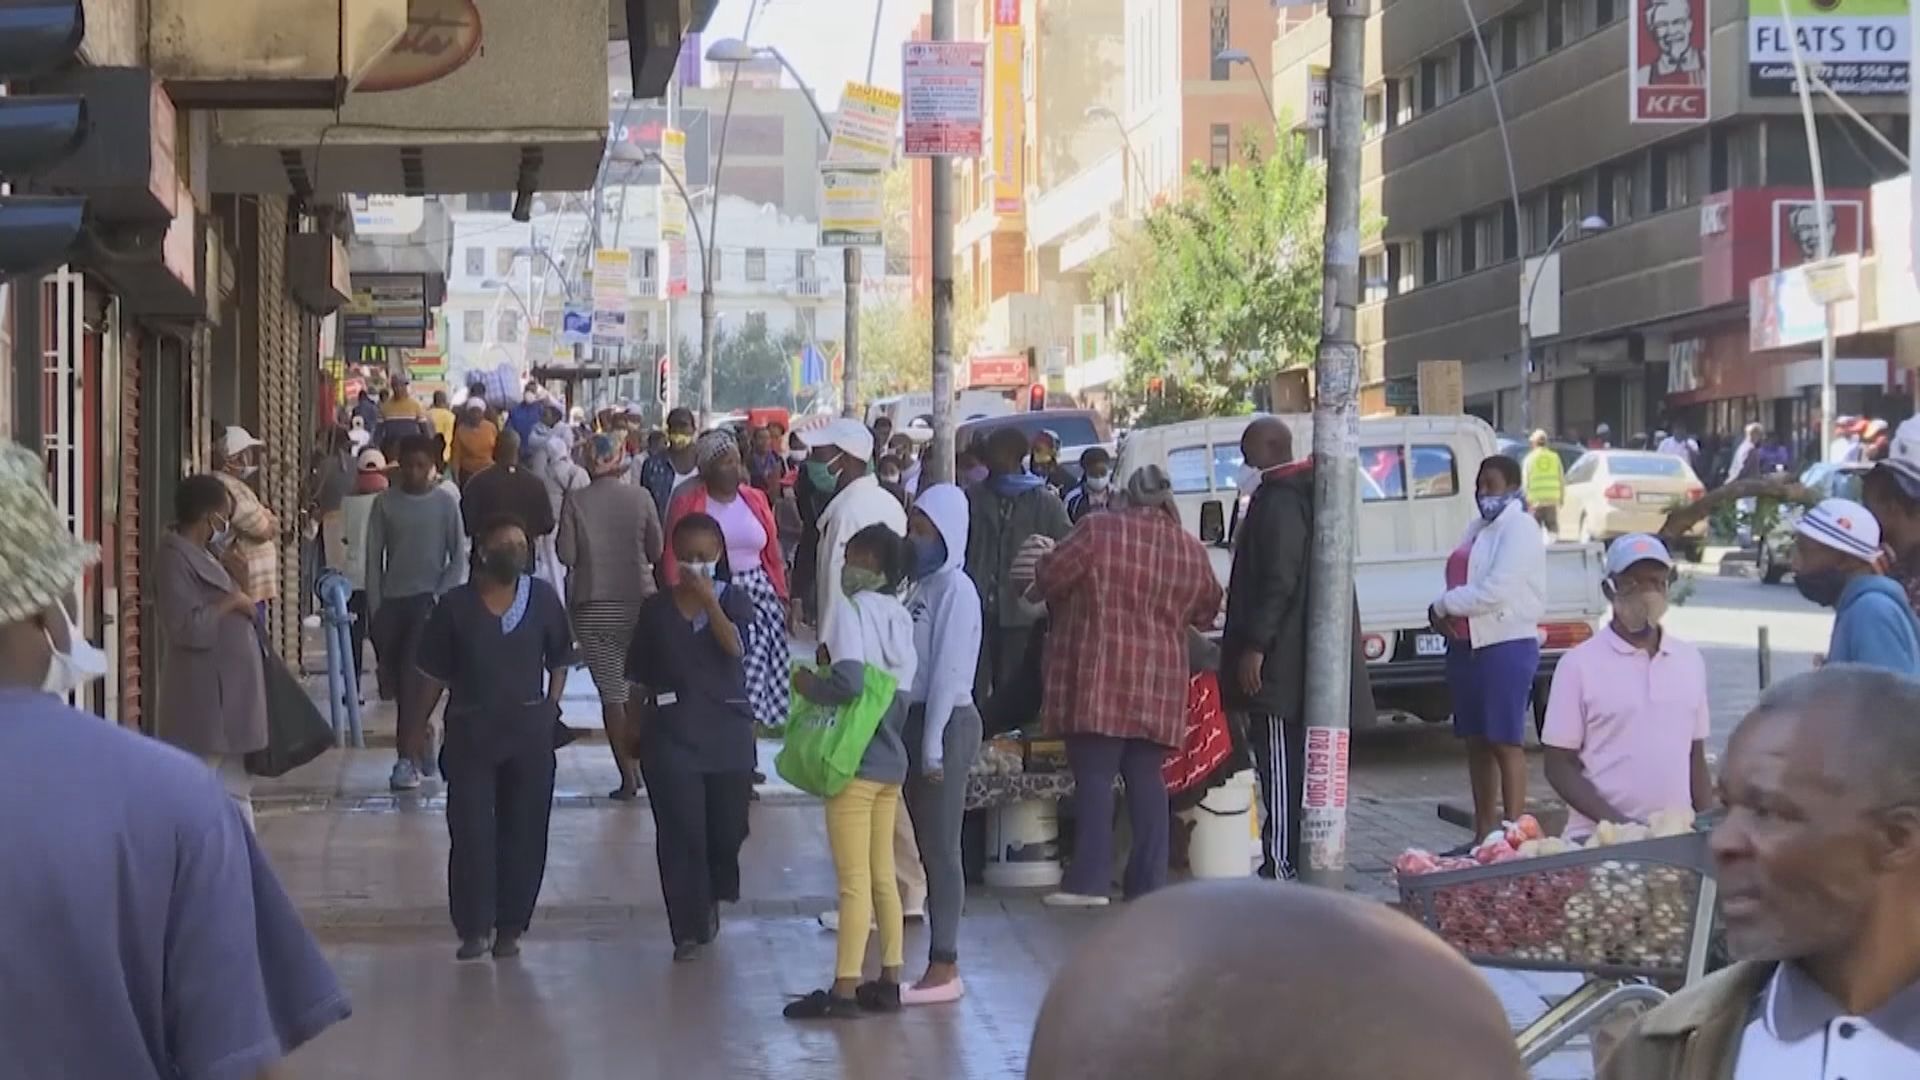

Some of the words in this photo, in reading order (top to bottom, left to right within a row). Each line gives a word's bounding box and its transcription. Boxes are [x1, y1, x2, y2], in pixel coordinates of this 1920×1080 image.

[1757, 26, 1845, 52] FLATS
[1857, 26, 1896, 52] TO
[1646, 96, 1699, 112] KFC
[1333, 731, 1347, 808] ABORTION
